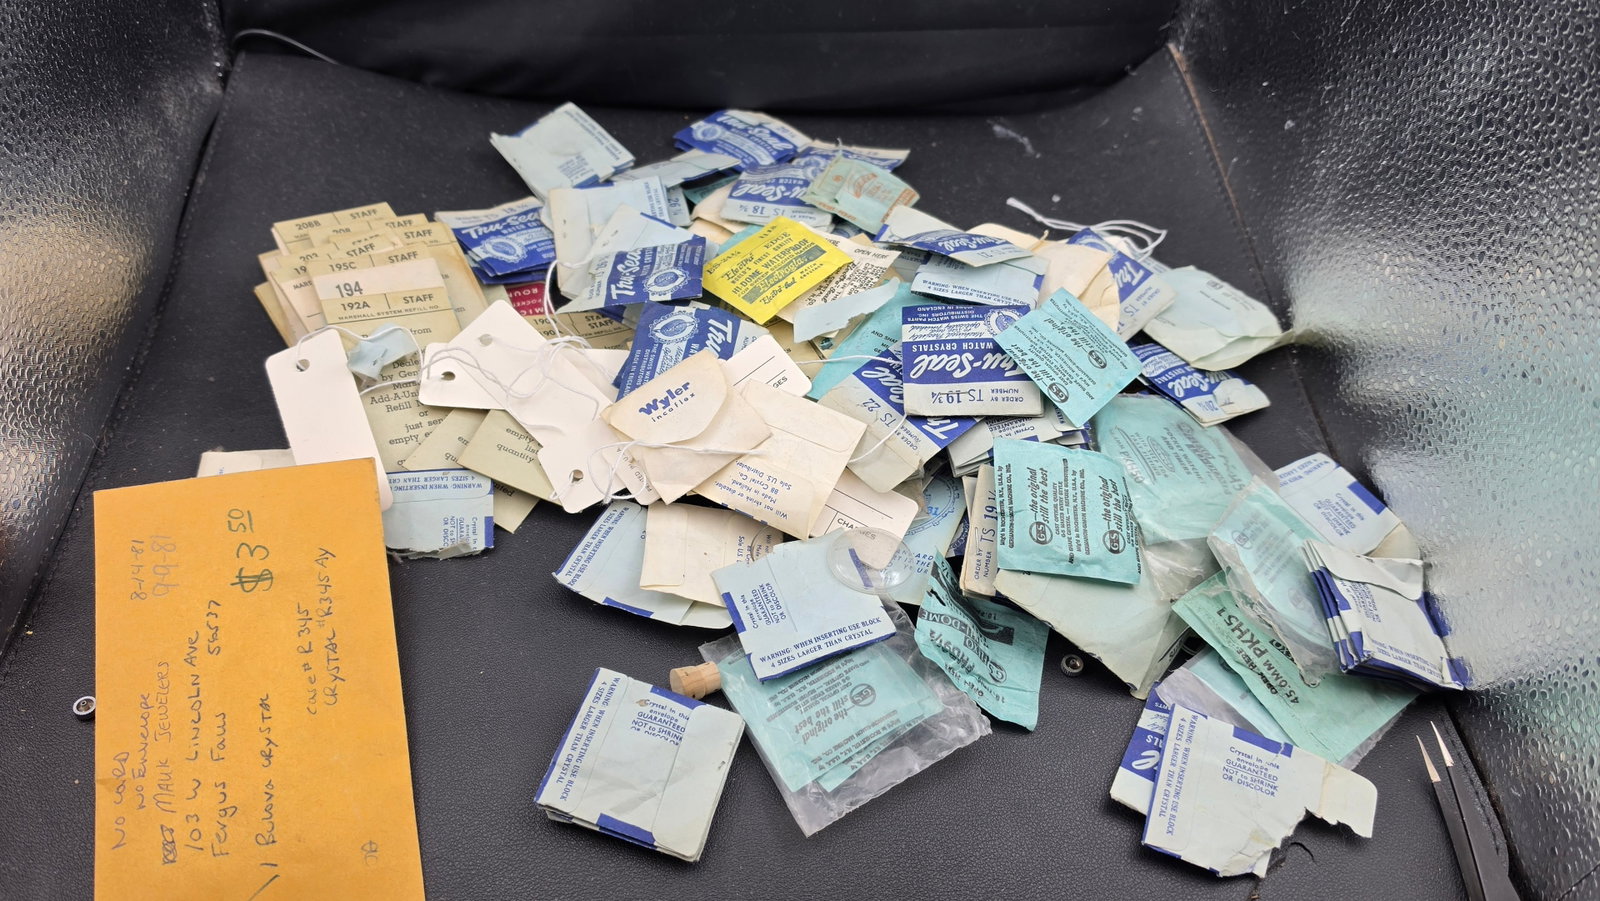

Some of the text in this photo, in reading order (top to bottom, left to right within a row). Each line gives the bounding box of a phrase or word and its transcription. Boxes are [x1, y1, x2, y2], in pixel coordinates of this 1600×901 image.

[350, 209, 378, 220] STAFF
[404, 229, 433, 239] STAFF
[329, 251, 419, 273] 195C STAFF
[346, 243, 376, 258] STAFF
[761, 239, 810, 269] WATERPROOF
[854, 248, 870, 256] OPEN
[335, 281, 364, 299] 194
[340, 293, 434, 311] 192A STAFF
[410, 327, 432, 335] from
[588, 318, 615, 330] STAFF
[871, 330, 883, 338] AND
[911, 342, 994, 352] WATCH CRYSTALS
[1066, 323, 1095, 350] still the
[1004, 344, 1033, 372] original
[1009, 341, 1056, 384] still the best
[381, 374, 394, 383] by
[772, 375, 788, 389] GES
[638, 381, 691, 416] Wyler
[946, 392, 962, 404] 19
[968, 388, 984, 402] TS
[385, 403, 412, 414] Refill
[418, 410, 430, 418] or
[862, 397, 897, 428] TS 22
[404, 421, 423, 434] just
[505, 427, 535, 444] empty
[389, 433, 419, 446] empty
[523, 444, 540, 456] list
[496, 442, 535, 464] quantity
[735, 459, 764, 478] Distributor.
[394, 484, 428, 492] INSERTING
[730, 478, 777, 504] Made Holland.
[738, 471, 770, 491] Crystal Co.
[1027, 467, 1039, 499] original
[1098, 475, 1111, 507] original
[1038, 467, 1049, 524] still the best
[745, 496, 788, 520] Will not shrink
[1111, 498, 1123, 532] still the
[565, 512, 616, 577] SIZES LARGER THAN CRYSTAL
[981, 527, 996, 543] TS
[567, 526, 615, 587] WHEN INSERTING USE BLOCK
[983, 551, 992, 578] NUMBER
[749, 599, 763, 621] envelope
[751, 589, 772, 626] GUARANTEED
[758, 584, 781, 624] NOT SHRINK
[765, 582, 787, 620] OR DISCOLOR
[207, 599, 223, 656] 56537
[749, 613, 759, 629] Crystal
[793, 616, 882, 651] WHEN INSERTING USE BLOCK
[777, 654, 796, 666] SIZES
[797, 644, 823, 659] LARGER
[825, 637, 843, 649] THAN
[844, 628, 874, 643] CRYSTAL
[1217, 606, 1300, 705] 45.0MM PKH51
[592, 687, 605, 704] SIZES
[581, 705, 594, 731] LARGER
[644, 698, 690, 721] Crystal this
[649, 708, 679, 723] envelope
[794, 694, 850, 735] still the best
[631, 719, 648, 731] NOT
[657, 727, 683, 742] SHRINK
[637, 711, 686, 733] GUARANTEED
[802, 715, 833, 745] original
[570, 731, 584, 752] THAN
[559, 708, 606, 802] WHEN INSERTING USE BLOCK
[1229, 746, 1254, 761] Crystal
[1236, 757, 1269, 772] envelope
[556, 753, 573, 784] CRYSTAL
[1158, 723, 1186, 818] SIZES LARGER THAN CRYSTAL
[1222, 766, 1279, 791] NOT SHRINK
[1225, 758, 1279, 782] GUARANTEED
[186, 776, 200, 801] W
[1166, 747, 1191, 836] WHEN INSERTING USE BLOCK
[1222, 773, 1276, 798] OR DISCOLOR
[209, 780, 238, 857] Fergus
[184, 812, 203, 851] 103
